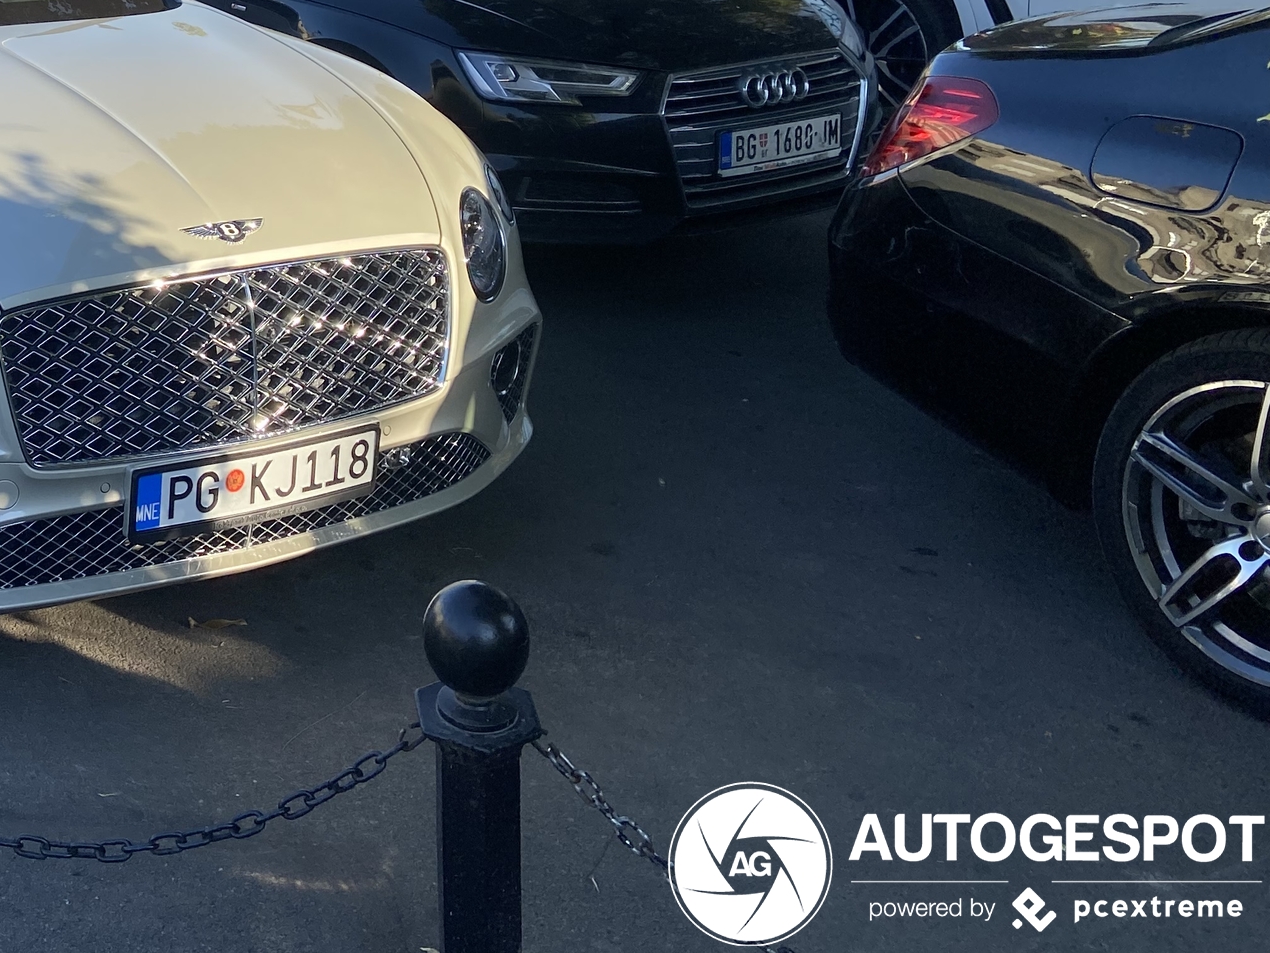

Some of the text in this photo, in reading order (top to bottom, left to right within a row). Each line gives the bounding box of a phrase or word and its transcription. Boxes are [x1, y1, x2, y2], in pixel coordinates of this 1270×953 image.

[736, 133, 757, 163] BG
[135, 501, 160, 523] MNE
[167, 470, 220, 520] PG
